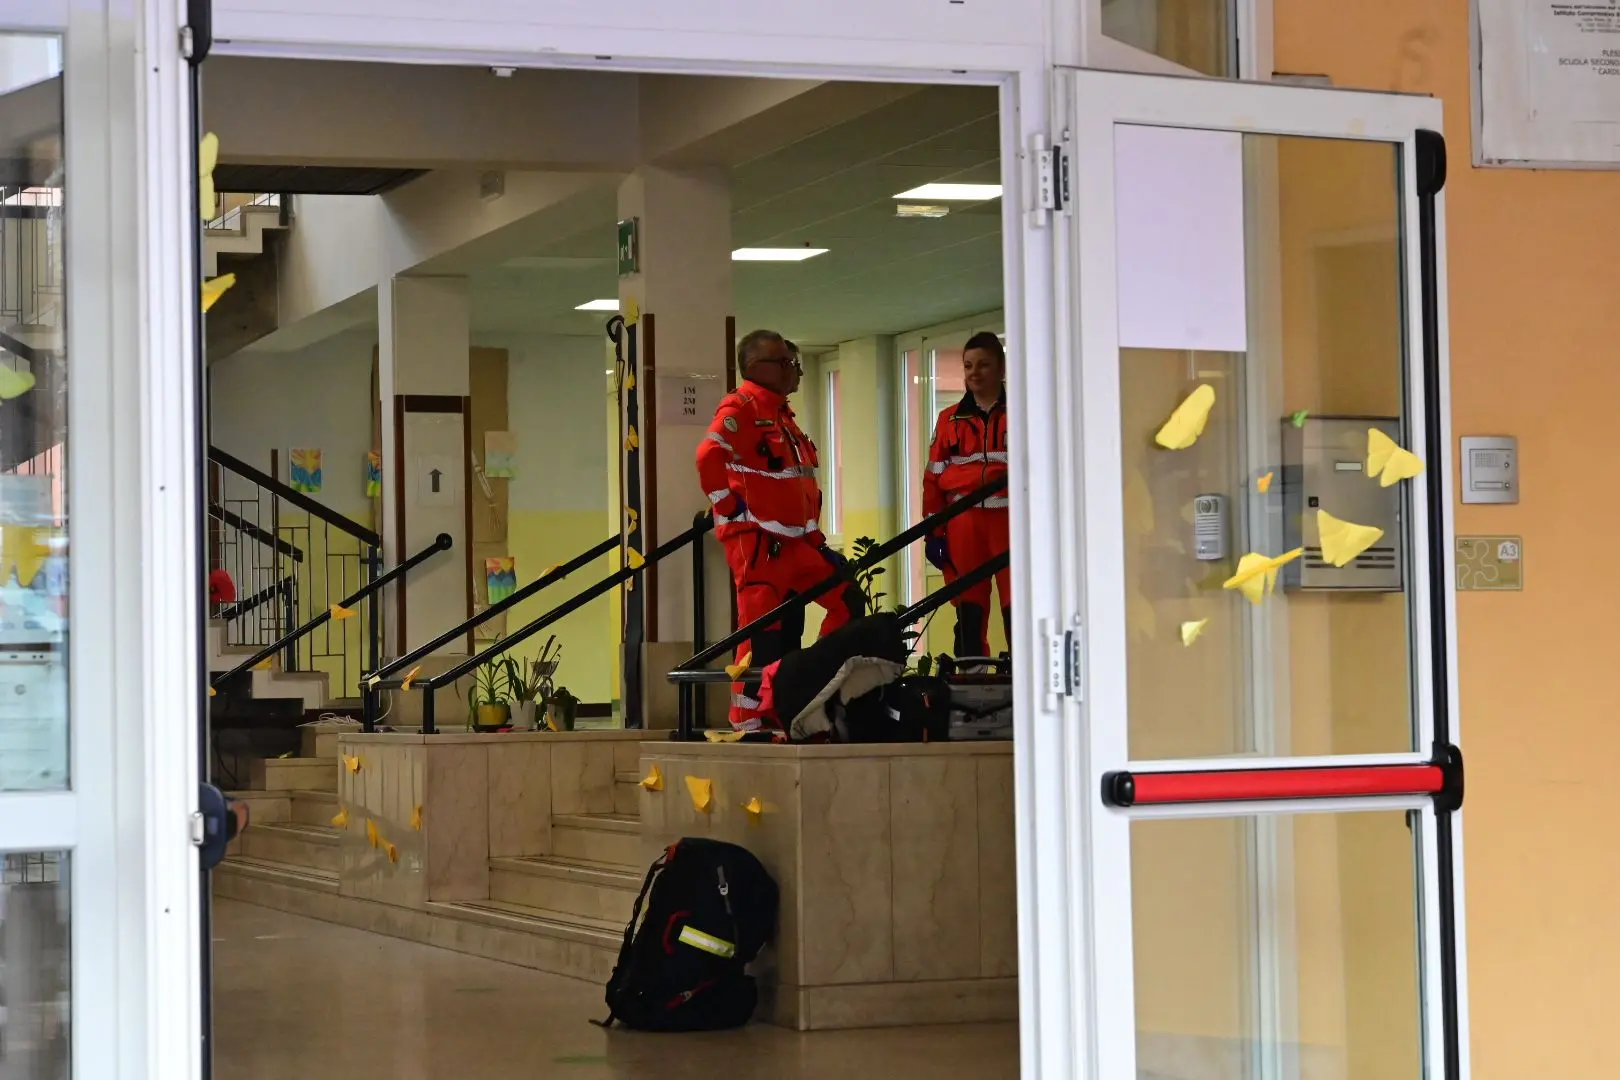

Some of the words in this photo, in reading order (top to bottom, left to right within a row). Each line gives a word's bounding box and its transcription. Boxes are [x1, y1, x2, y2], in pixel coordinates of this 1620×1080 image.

[1559, 58, 1588, 66] SCUOLA
[1590, 58, 1620, 66] SECOND
[684, 386, 696, 394] 1M
[684, 397, 696, 405] 2M
[683, 407, 696, 416] 3M
[1500, 544, 1517, 557] A3
